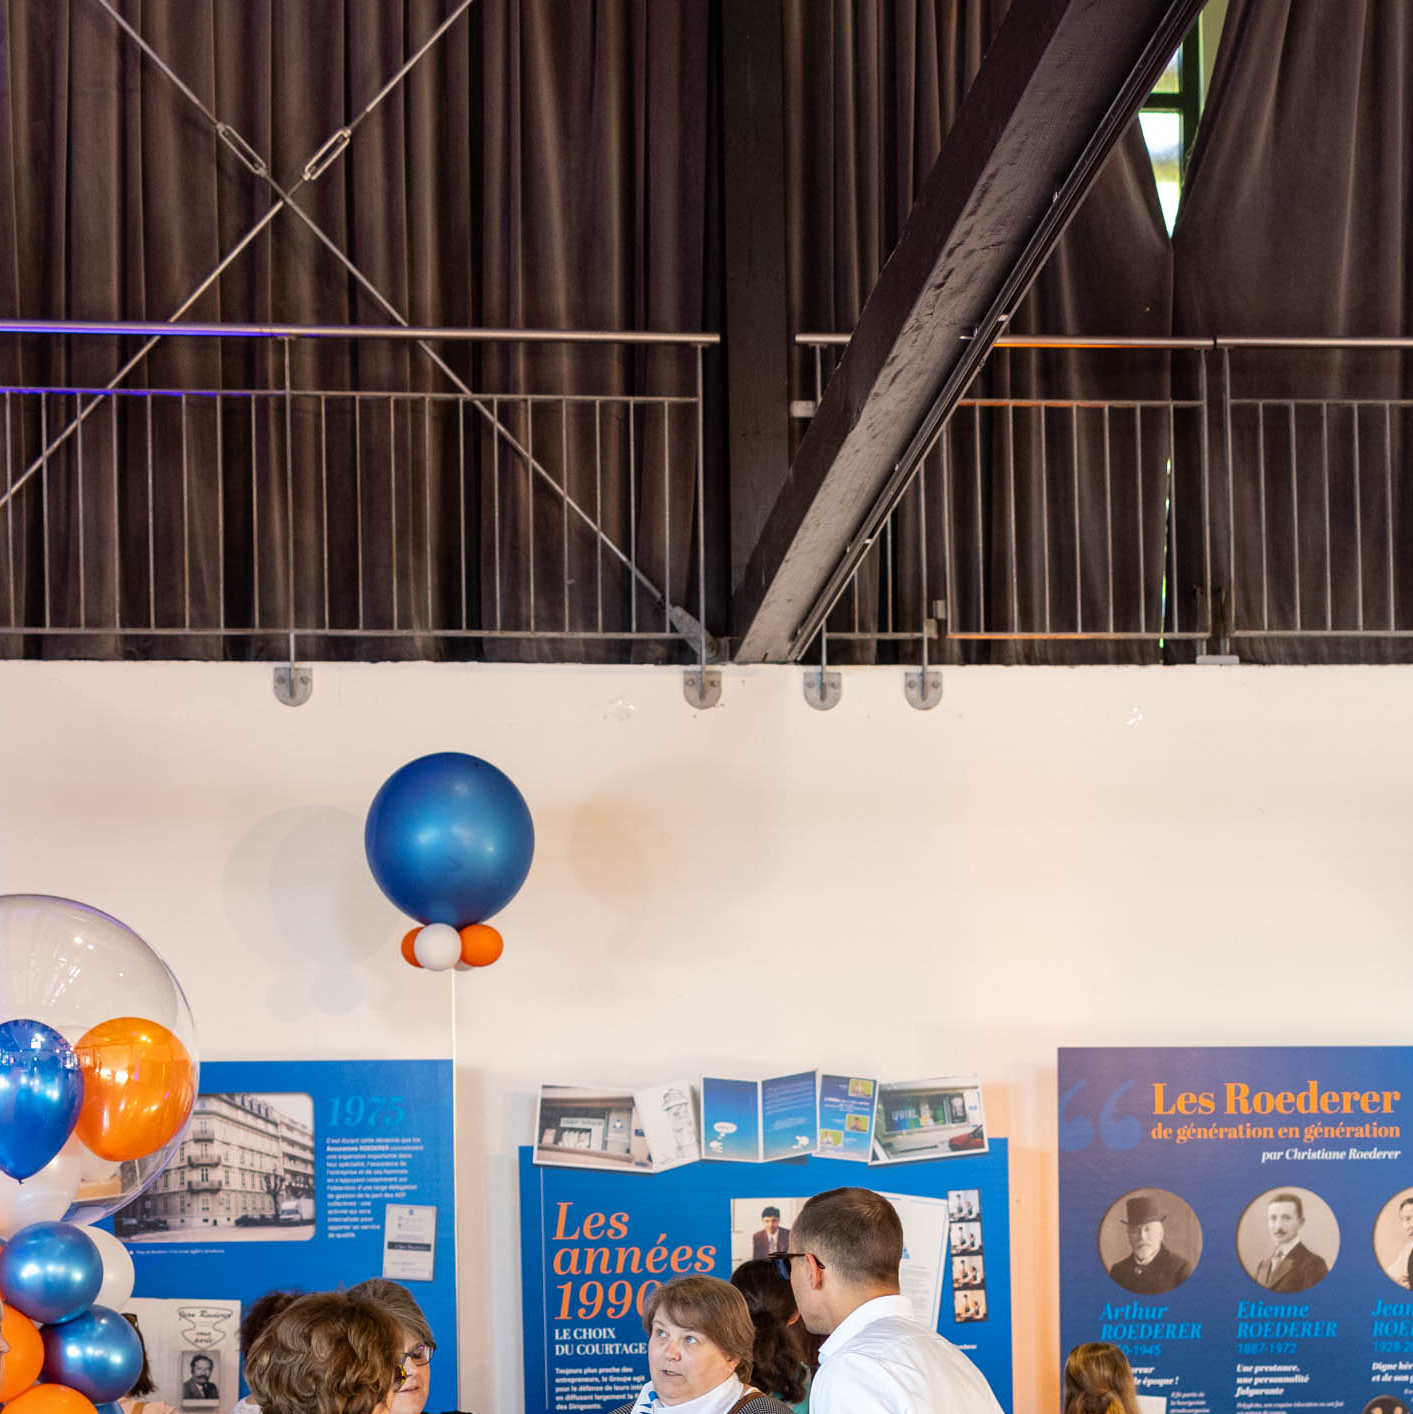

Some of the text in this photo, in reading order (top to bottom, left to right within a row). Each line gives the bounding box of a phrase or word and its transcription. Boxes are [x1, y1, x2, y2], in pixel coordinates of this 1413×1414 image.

[1152, 1080, 1401, 1115] Les Roederer
[328, 1096, 404, 1128] 1975
[1151, 1121, 1401, 1143] de génération en génération
[1262, 1147, 1401, 1163] par Christiane Roederer
[552, 1202, 628, 1241] Les
[553, 1233, 716, 1275] années
[1100, 1301, 1168, 1320] Arthur
[1237, 1300, 1309, 1318] Etienne
[555, 1328, 615, 1340] LE CHOIX
[1101, 1322, 1202, 1340] ROEDERER
[1236, 1321, 1338, 1339] ROEDERER
[555, 1343, 647, 1356] DU COURTAGE
[555, 1367, 582, 1375] Toujours
[583, 1367, 597, 1375] plus
[598, 1366, 620, 1374] proche
[1236, 1364, 1252, 1372] Une
[1372, 1362, 1397, 1371] Digne
[555, 1376, 599, 1384] entrepreneurs,
[608, 1375, 631, 1383] Groupe
[1253, 1374, 1309, 1385] personnalité
[1382, 1374, 1392, 1382] de
[1234, 1387, 1284, 1397] fulgurante
